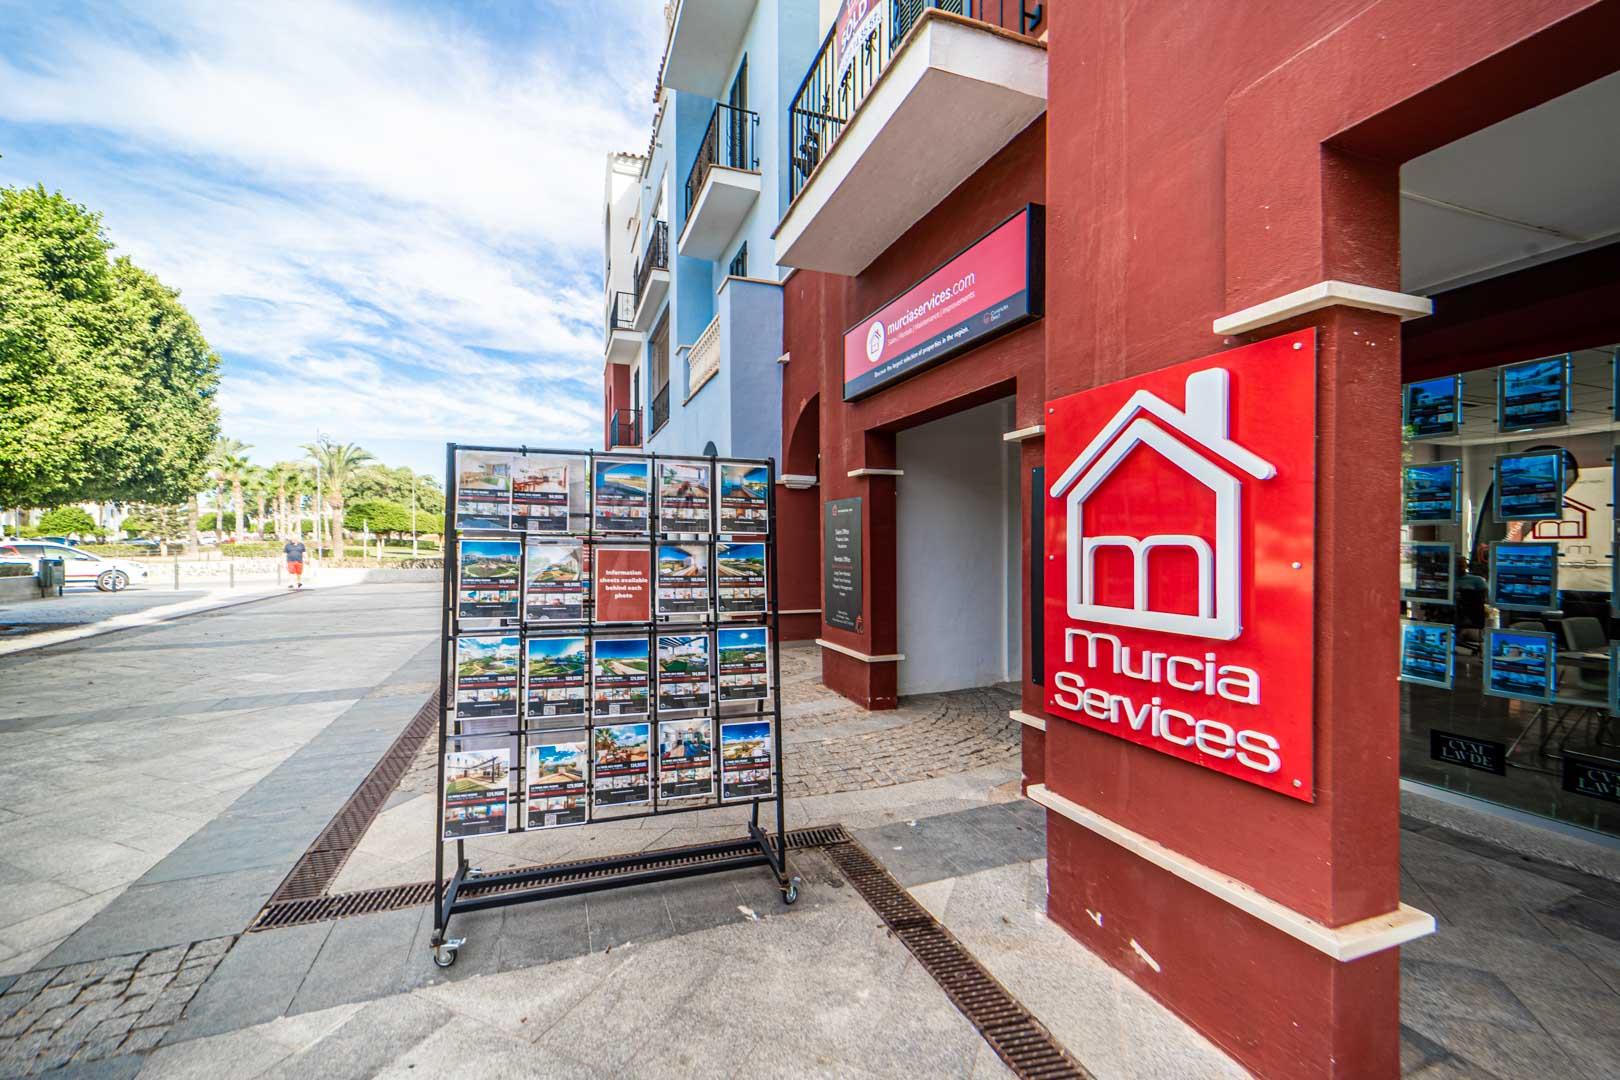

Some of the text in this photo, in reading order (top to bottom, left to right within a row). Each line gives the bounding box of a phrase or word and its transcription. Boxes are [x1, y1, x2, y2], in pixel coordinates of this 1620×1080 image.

[887, 272, 976, 335] murciaservices.com
[1064, 627, 1261, 705] murcia
[1053, 671, 1282, 774] Services
